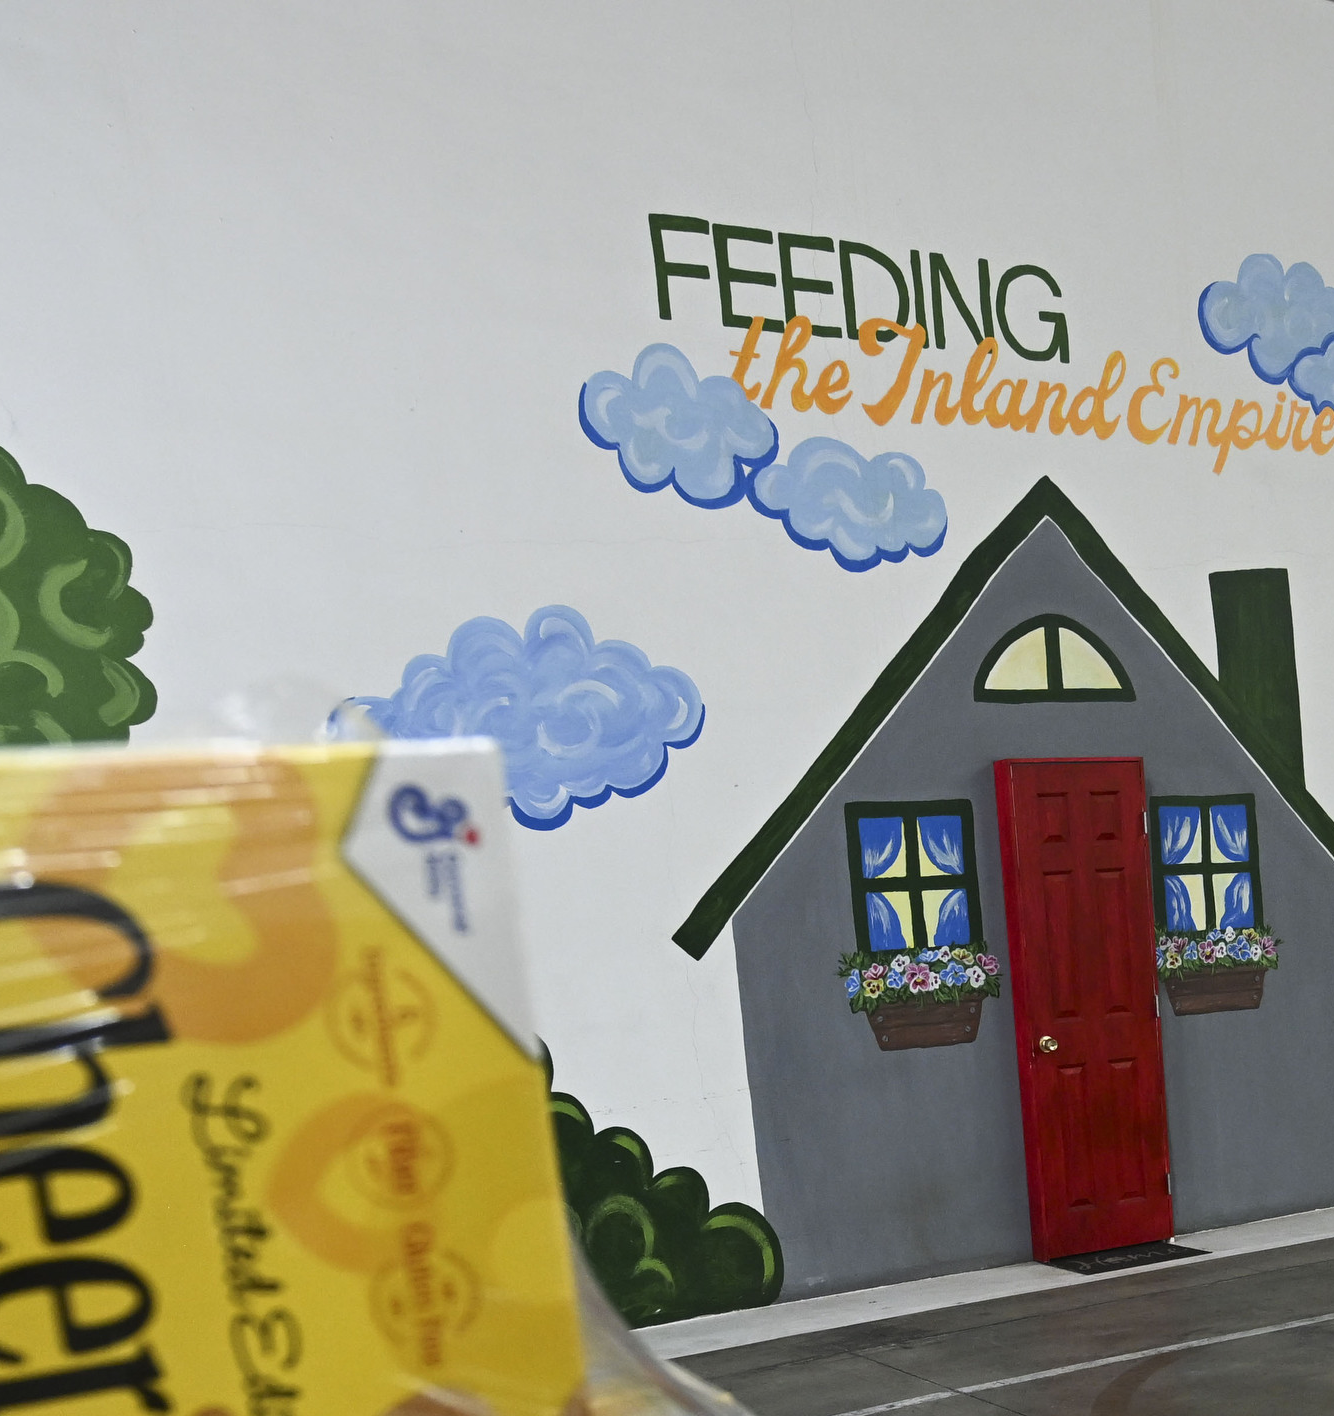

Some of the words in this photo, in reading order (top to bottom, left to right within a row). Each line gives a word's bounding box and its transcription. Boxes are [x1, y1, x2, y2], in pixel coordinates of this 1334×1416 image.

[648, 213, 1070, 364] FEEDING
[729, 315, 855, 417] the
[857, 317, 1127, 440] Inland
[180, 1069, 285, 1305] Limited
